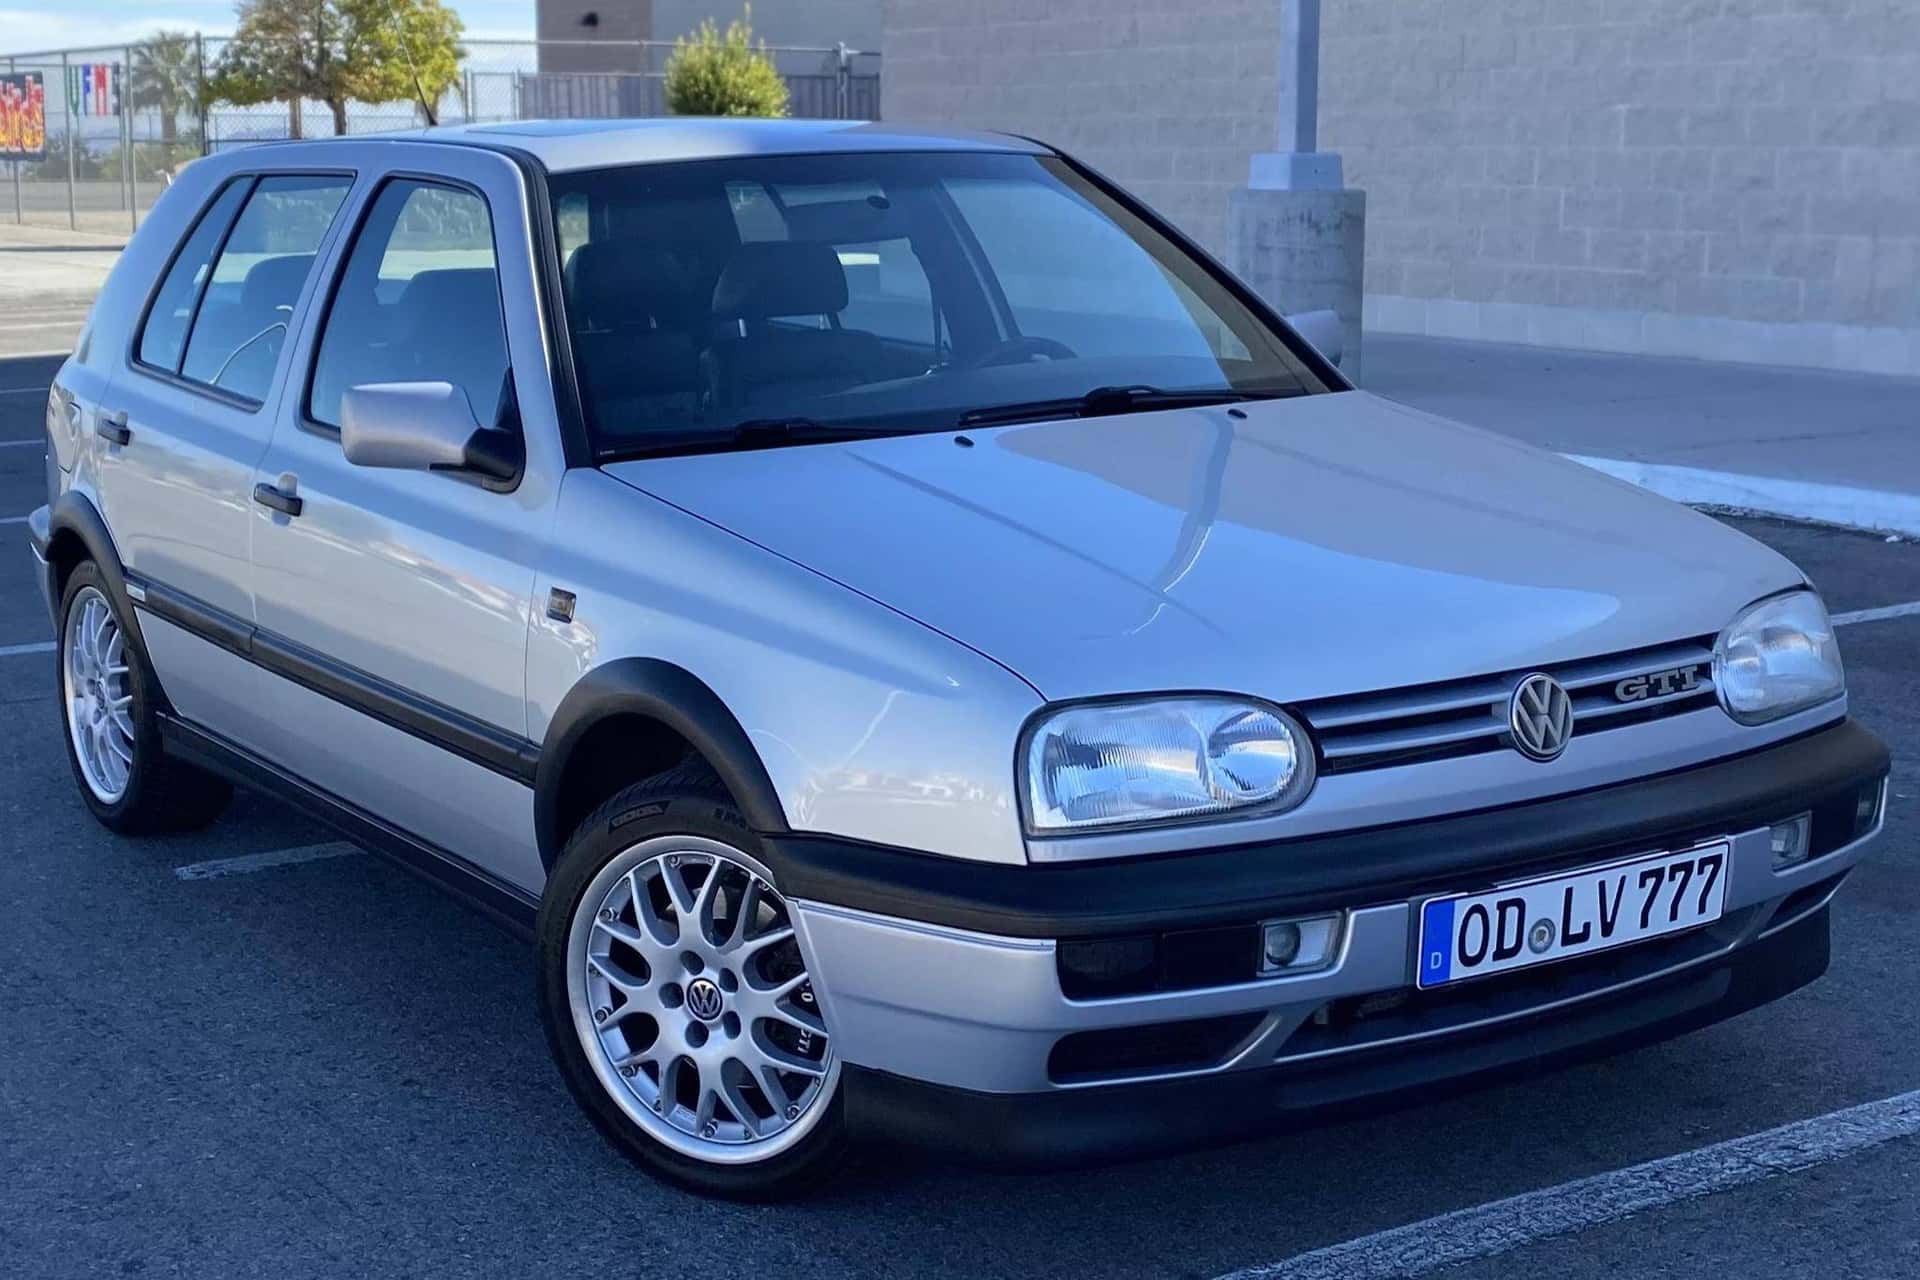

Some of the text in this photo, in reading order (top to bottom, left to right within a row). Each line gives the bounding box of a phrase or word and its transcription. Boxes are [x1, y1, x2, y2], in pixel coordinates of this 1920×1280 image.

[1615, 666, 1699, 702] GTI
[1512, 674, 1572, 756] VW
[1458, 853, 1724, 967] OD LV 777
[1430, 952, 1442, 970] D
